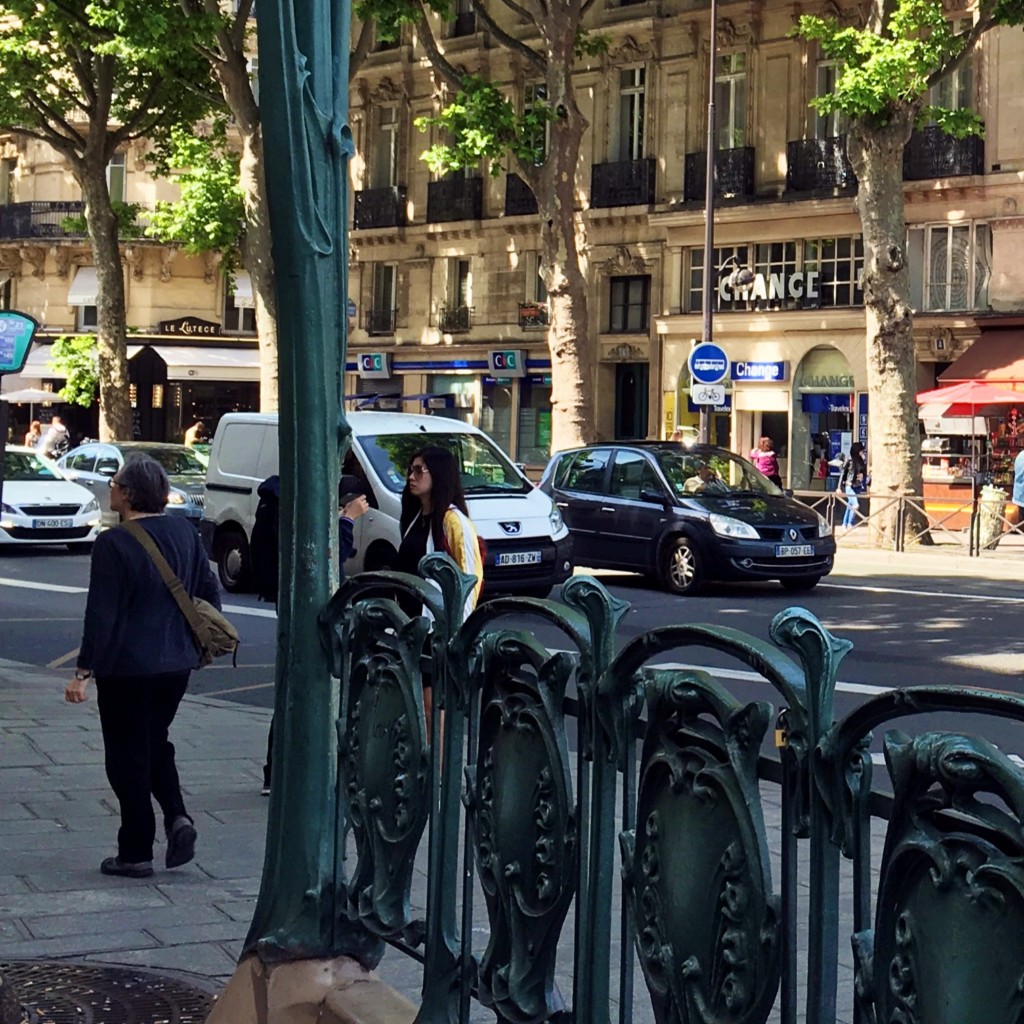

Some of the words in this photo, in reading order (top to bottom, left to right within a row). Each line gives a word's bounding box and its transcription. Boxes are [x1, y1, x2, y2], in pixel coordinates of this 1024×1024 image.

[363, 357, 382, 369] CIC
[495, 355, 515, 367] CIC
[736, 362, 779, 380] Change
